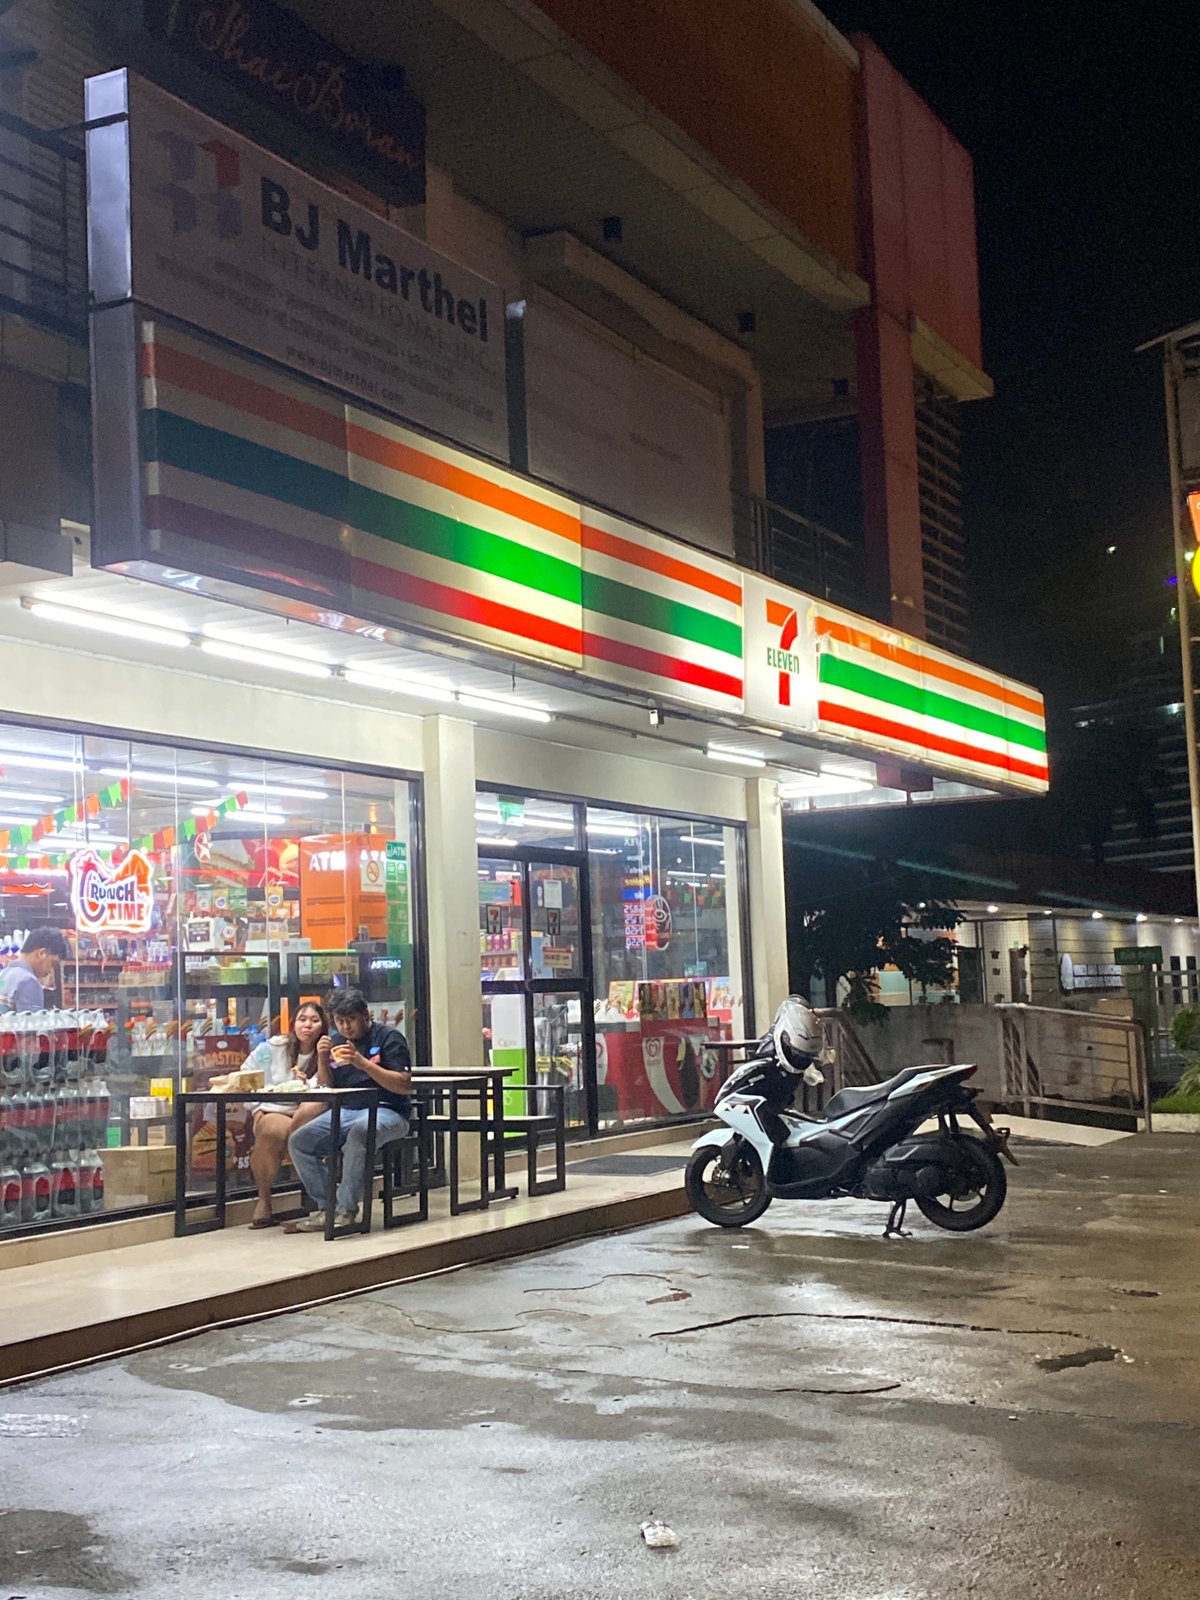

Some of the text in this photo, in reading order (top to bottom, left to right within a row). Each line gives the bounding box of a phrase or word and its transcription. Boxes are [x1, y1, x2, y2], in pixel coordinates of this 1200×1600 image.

[261, 176, 320, 252] BJ
[337, 218, 488, 343] Marthel
[261, 234, 443, 352] INTERNATIONAL
[766, 599, 798, 706] 7
[107, 903, 144, 921] TIME
[309, 850, 346, 872] ATM
